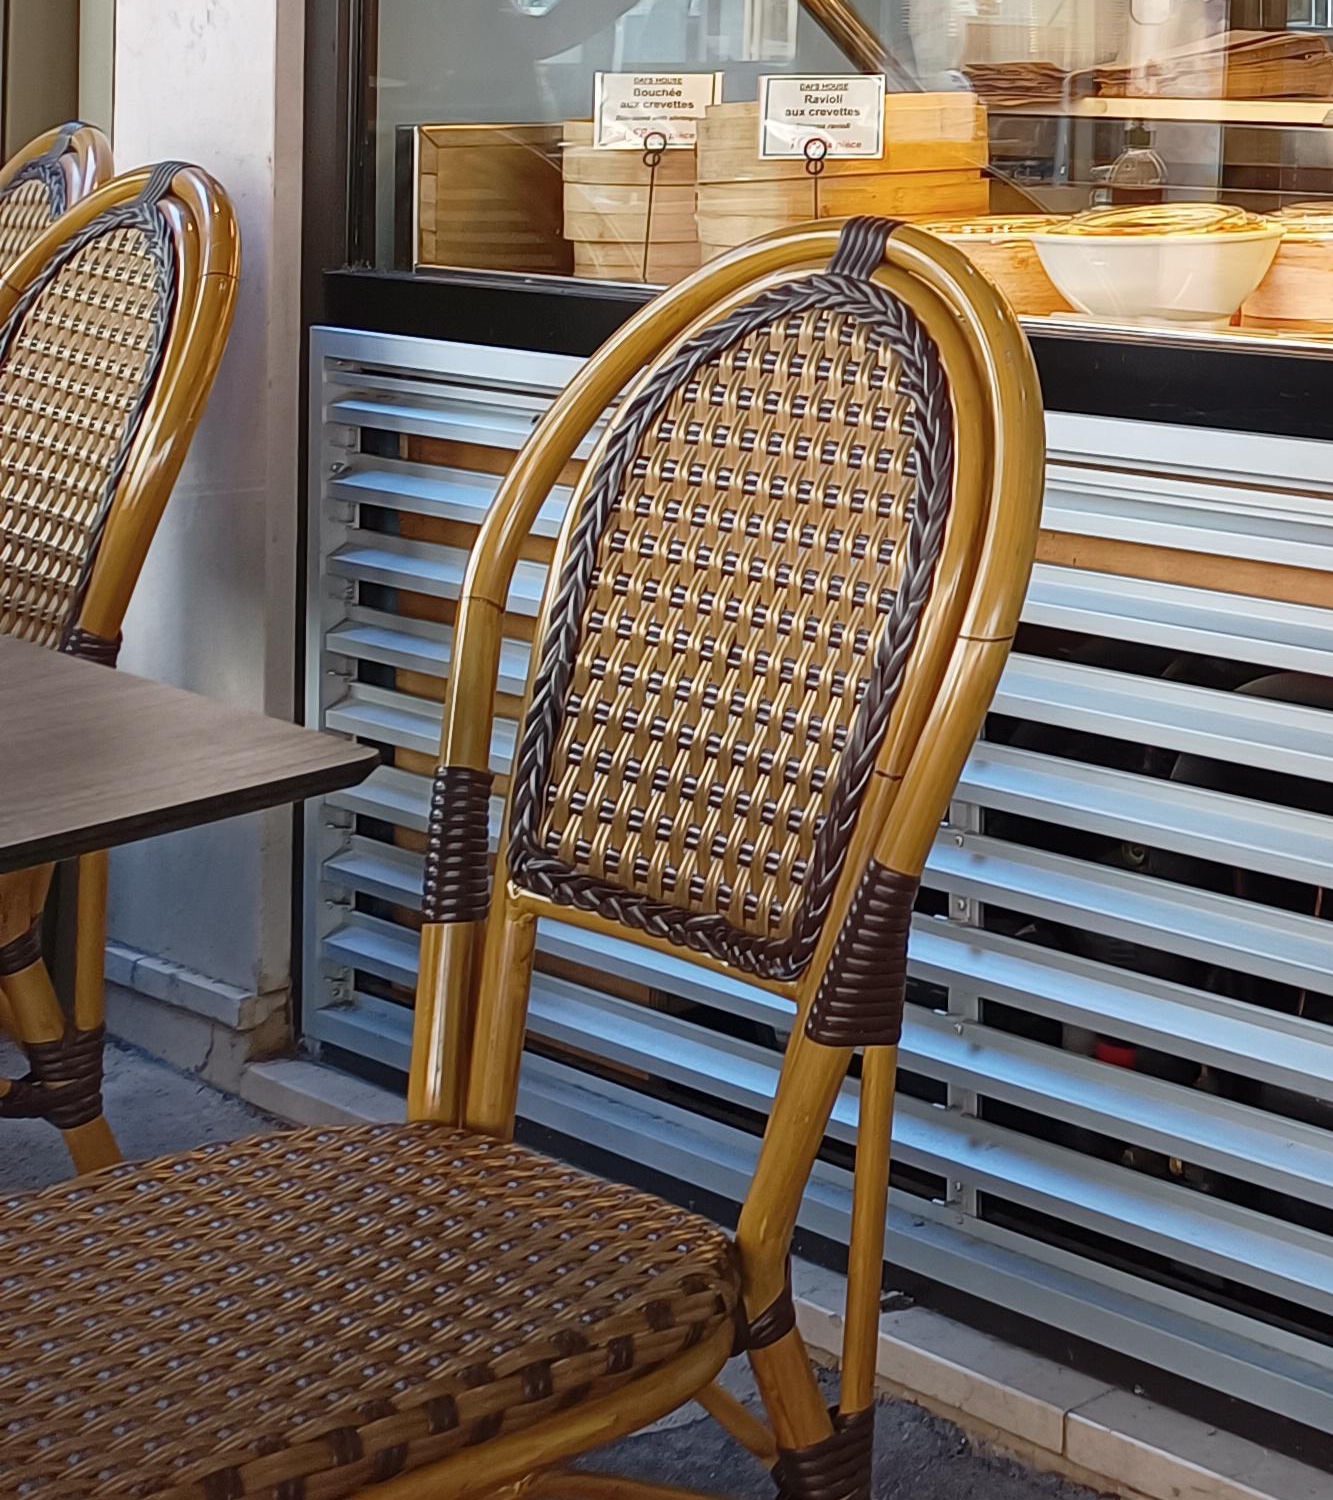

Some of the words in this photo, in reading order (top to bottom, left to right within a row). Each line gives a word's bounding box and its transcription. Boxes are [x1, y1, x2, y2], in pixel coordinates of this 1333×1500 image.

[633, 88, 682, 97] Bouchée
[804, 94, 843, 104] Ravioli
[643, 101, 695, 109] crevettes
[785, 108, 805, 116] aux
[808, 107, 861, 117] crevettes
